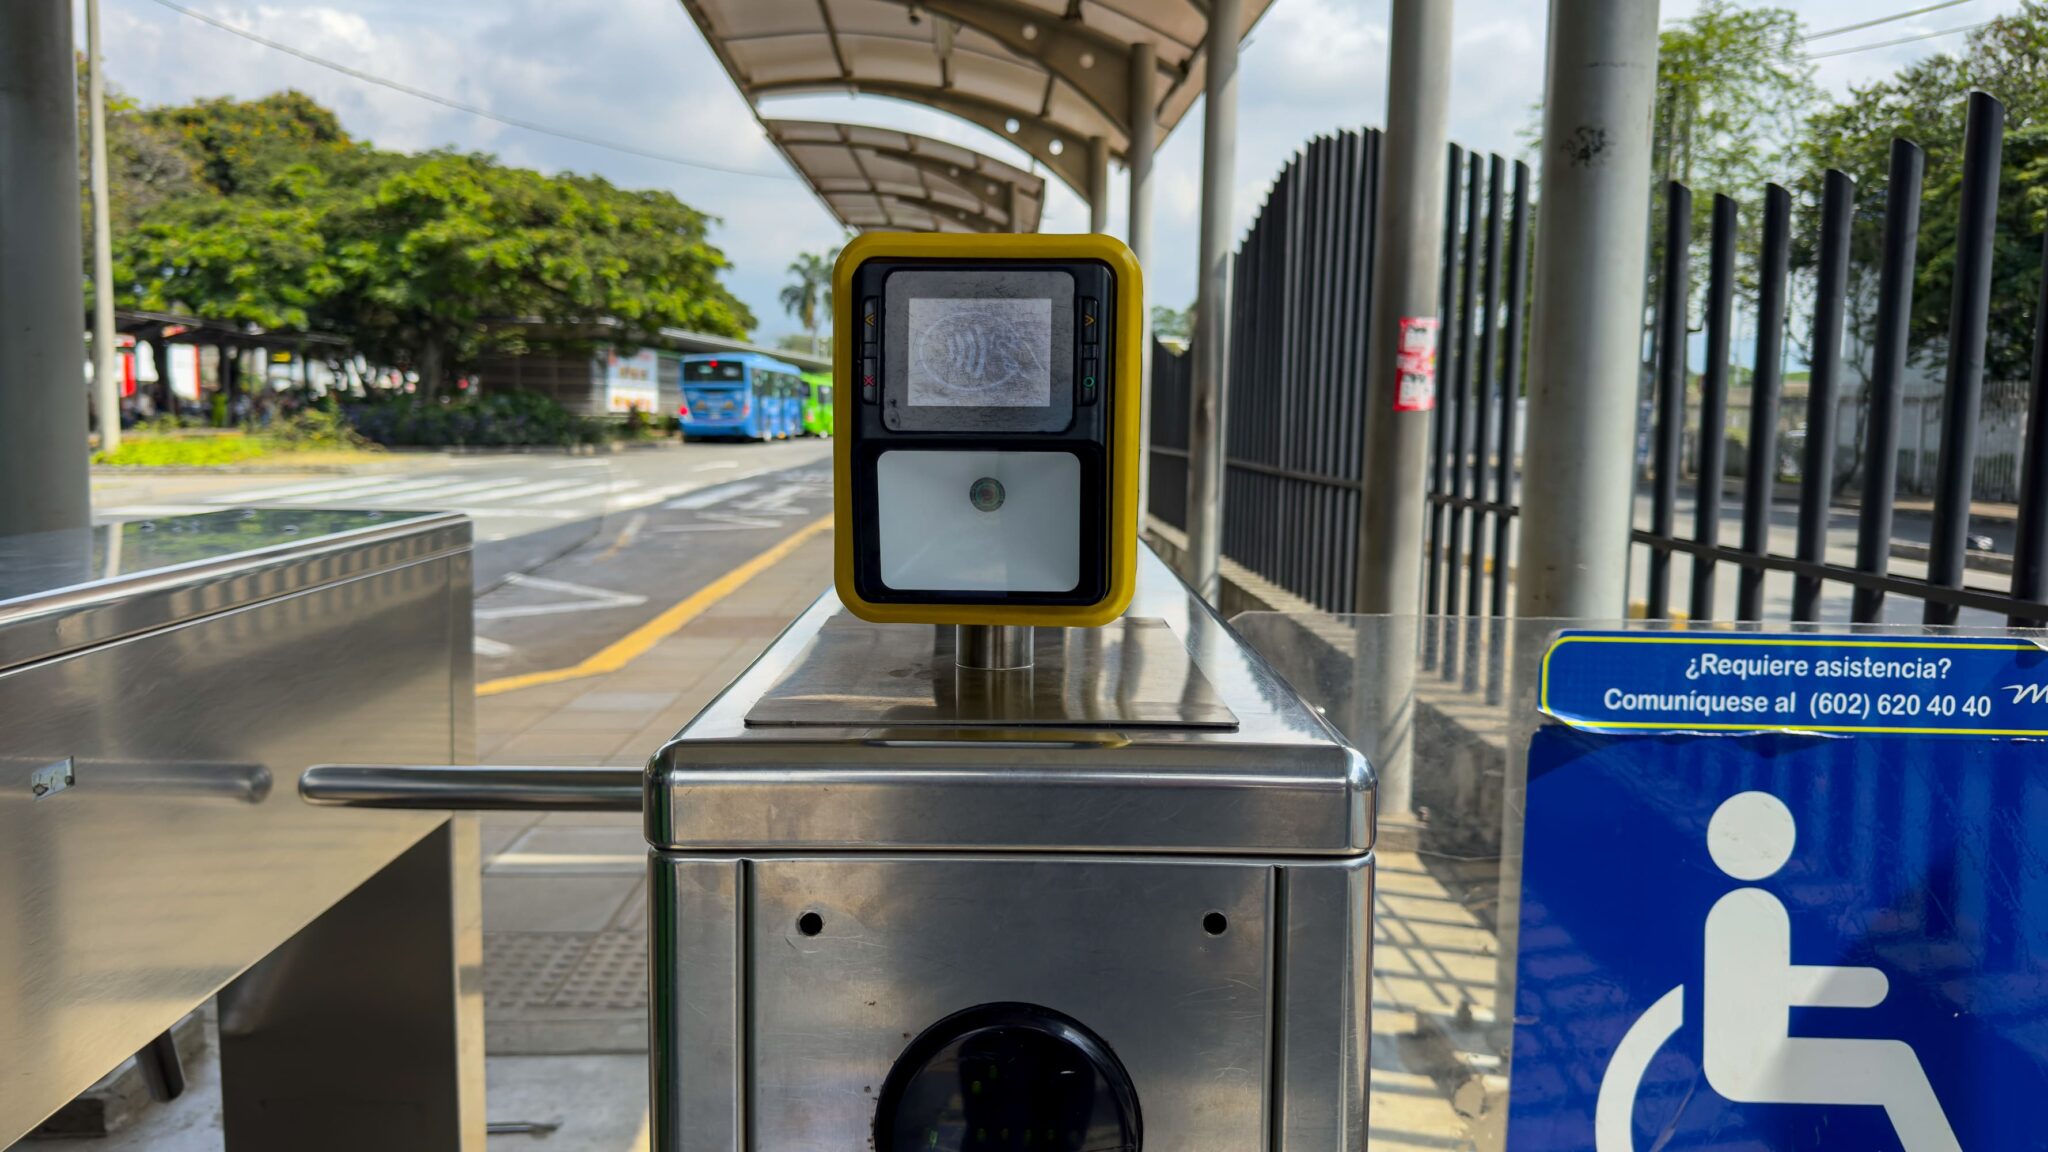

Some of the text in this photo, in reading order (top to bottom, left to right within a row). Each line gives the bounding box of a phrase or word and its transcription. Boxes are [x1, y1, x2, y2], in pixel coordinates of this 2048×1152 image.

[1685, 653, 1952, 681] ¿Requiere asistencia?
[1604, 688, 1991, 720] Comuníquese al (602) 620 40 40
